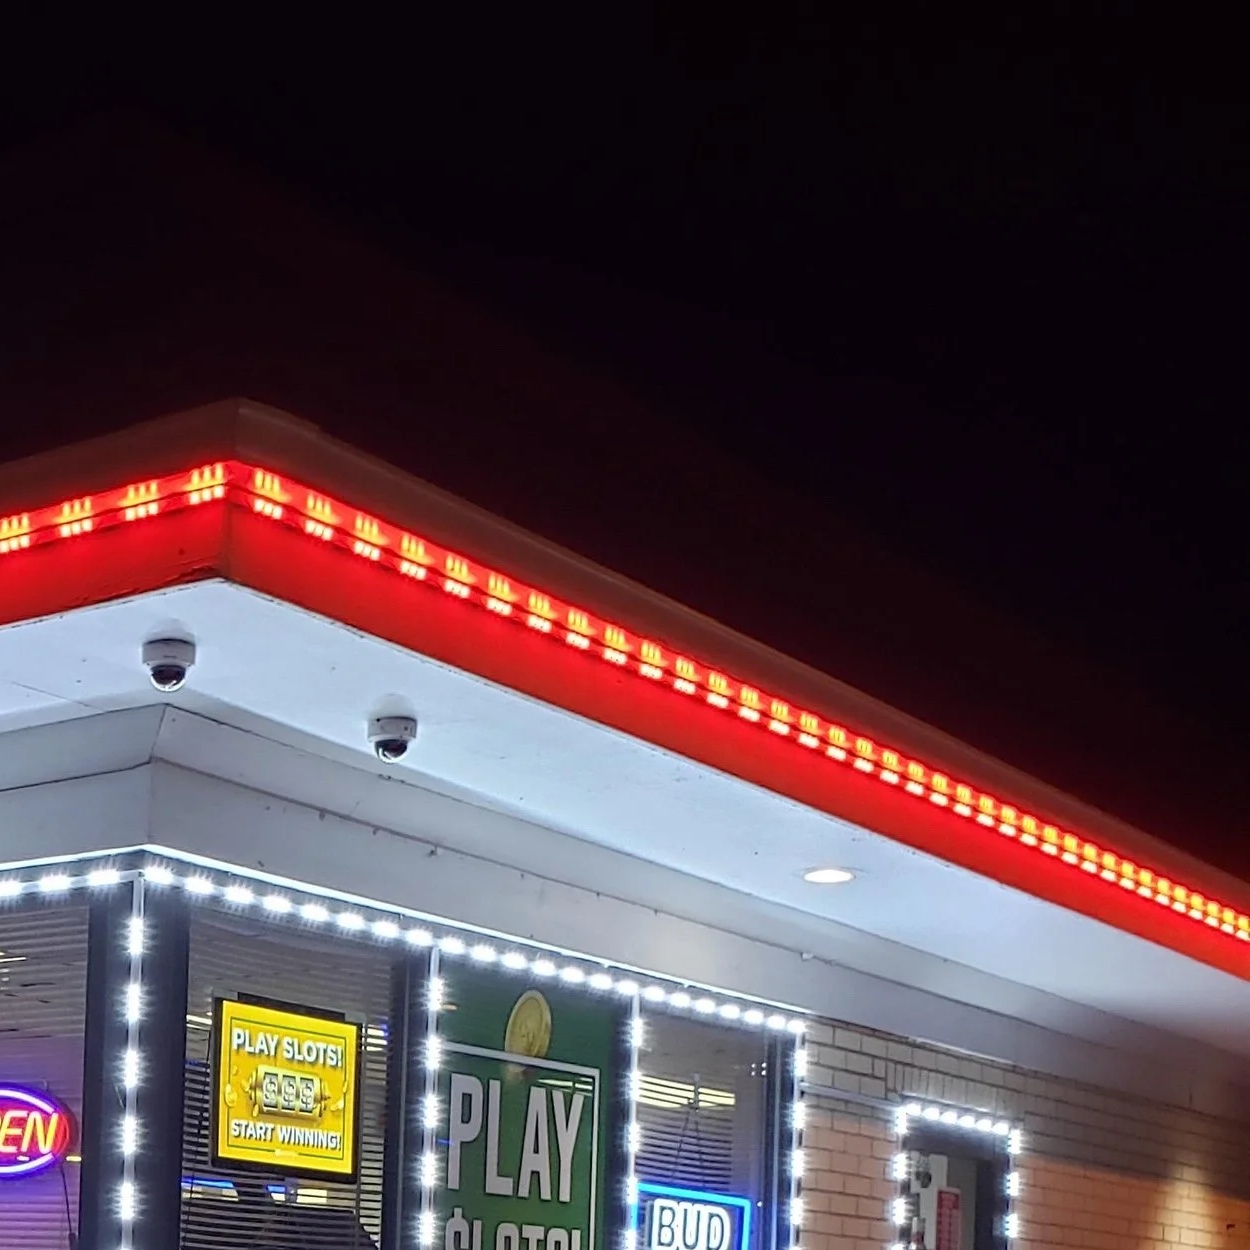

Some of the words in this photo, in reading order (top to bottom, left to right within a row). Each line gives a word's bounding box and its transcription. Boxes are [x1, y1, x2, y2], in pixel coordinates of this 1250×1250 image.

[231, 1027, 279, 1056] PLAY
[283, 1037, 343, 1067] SLOTS!
[231, 1119, 275, 1142] START
[278, 1125, 342, 1151] WINNING!
[447, 1073, 584, 1203] PLAY
